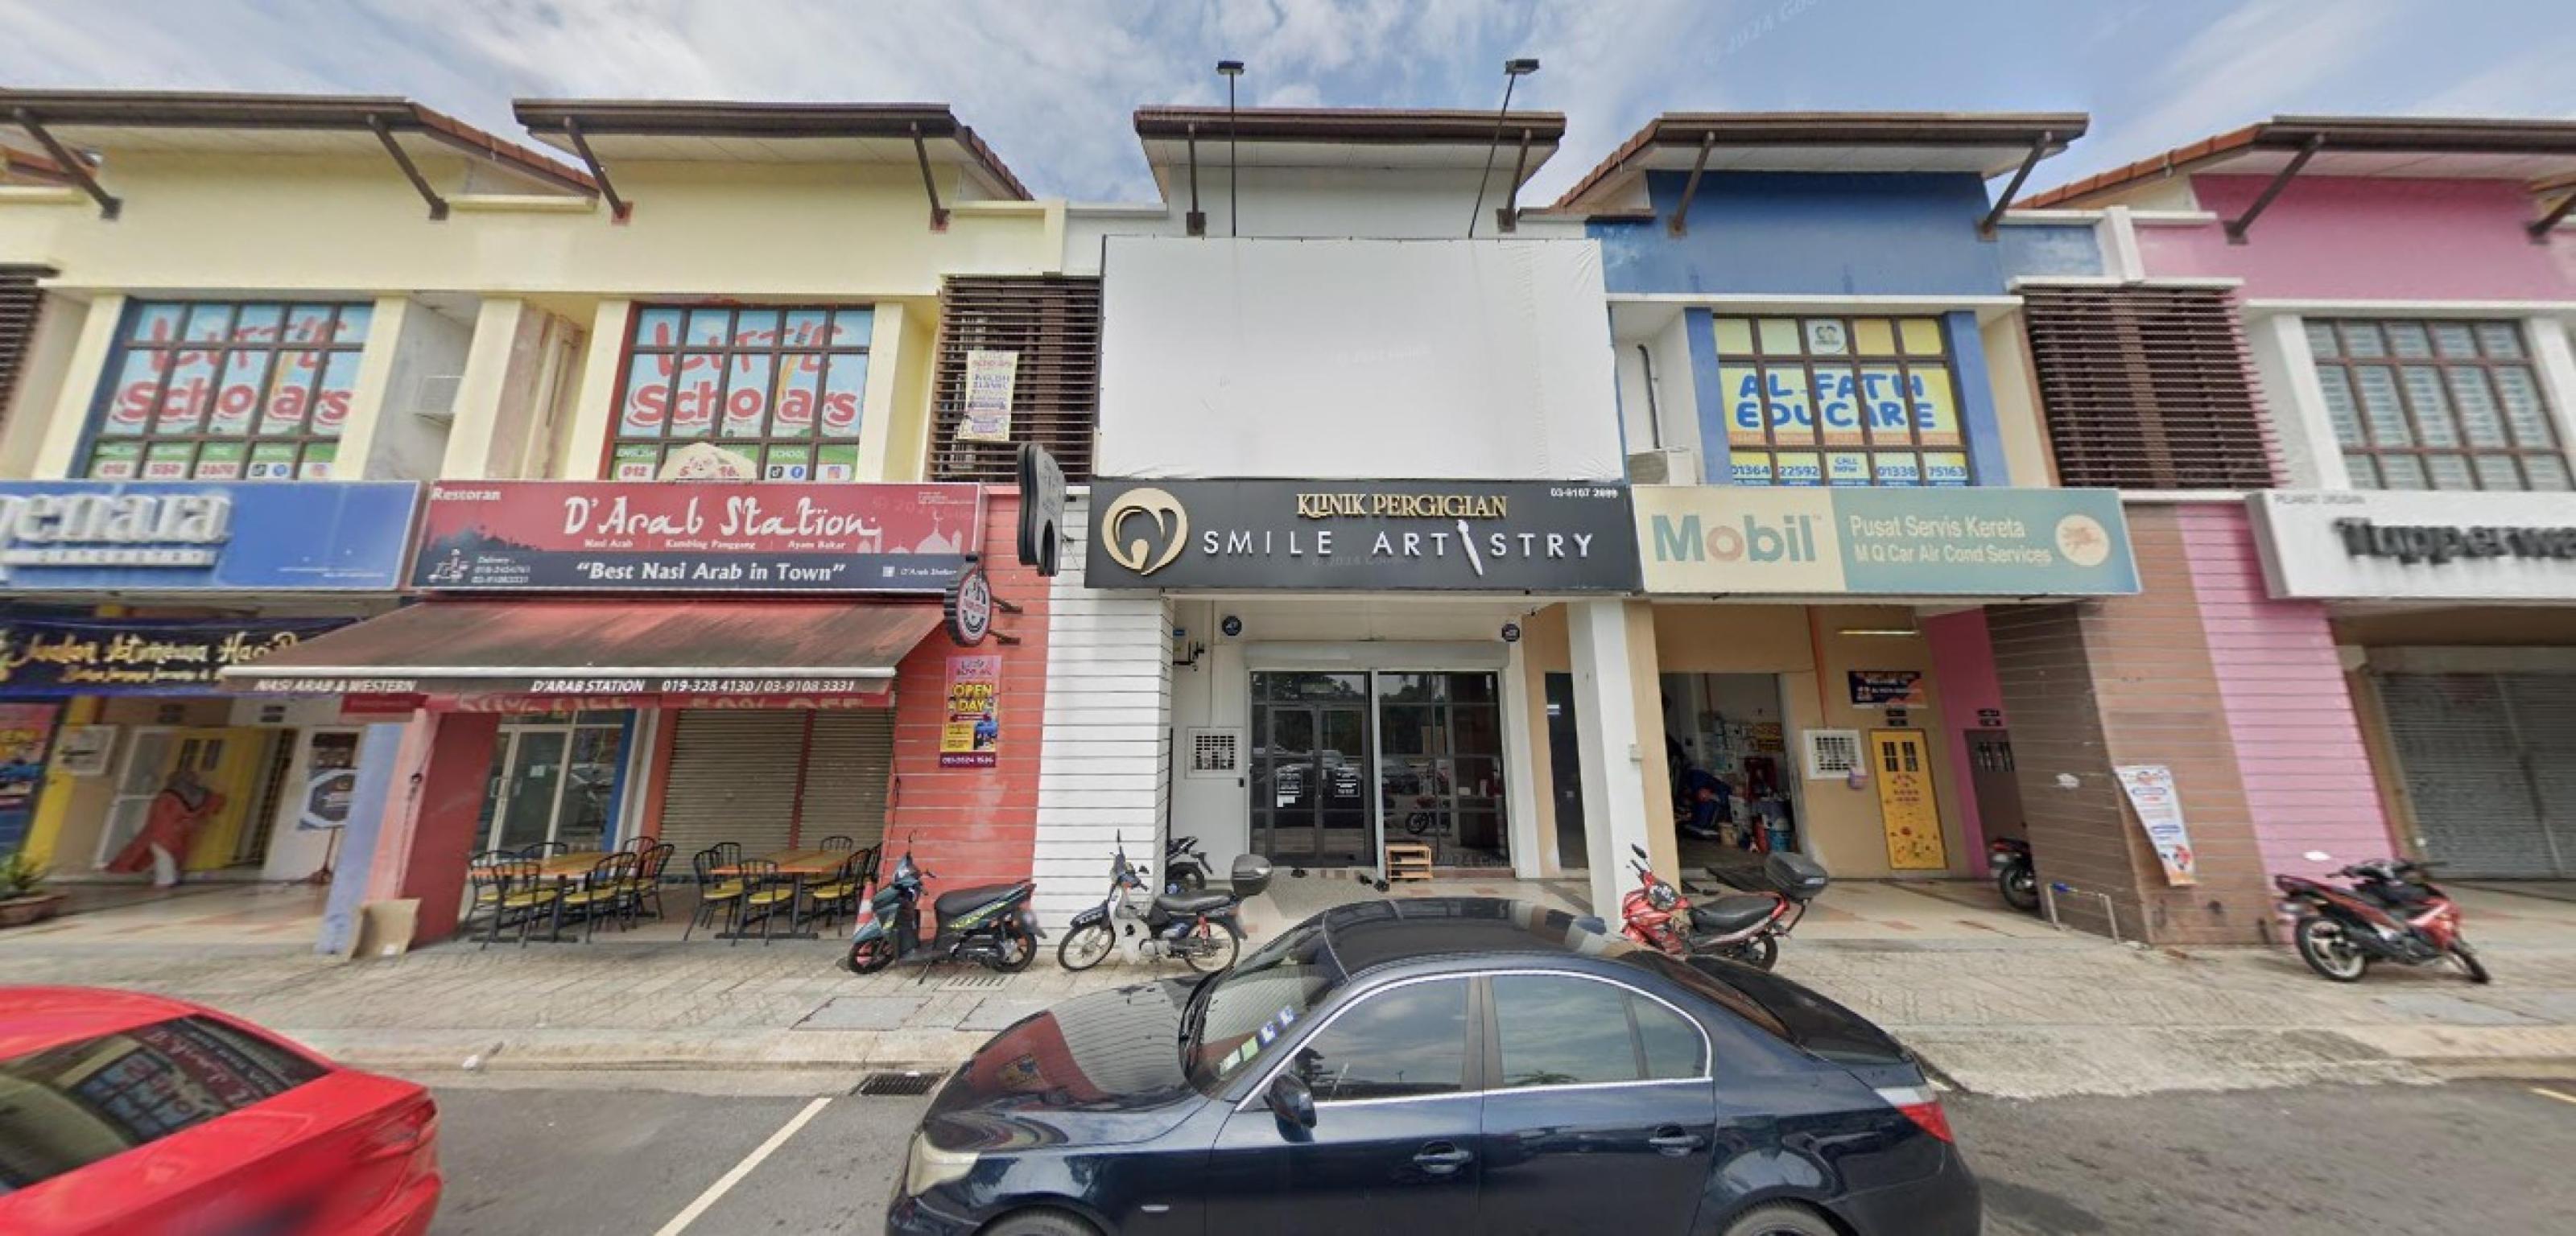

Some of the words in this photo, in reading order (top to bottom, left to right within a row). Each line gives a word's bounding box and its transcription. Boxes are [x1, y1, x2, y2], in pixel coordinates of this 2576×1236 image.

[1834, 456, 1858, 465] CALL
[431, 488, 502, 501] Restoran
[1372, 493, 1508, 517] PERGIGIAN
[0, 492, 232, 543] enara
[564, 495, 704, 535] D'Arab
[720, 495, 878, 536] Station
[1848, 514, 1902, 537] Pusat
[1905, 515, 1963, 538] Servis
[1964, 515, 2027, 538] Kereta
[584, 538, 608, 549] Nasi
[610, 538, 634, 549] Arab
[1203, 530, 1333, 557] SMILE
[1650, 513, 1816, 562] Mobil
[1854, 543, 1868, 562] M
[1871, 544, 1885, 563] Q
[1887, 544, 1915, 562] Car
[1919, 544, 1940, 562] Air
[1942, 545, 1984, 563] Cond
[1985, 545, 2054, 566] Services
[642, 561, 686, 580] Nasi
[691, 561, 742, 580] Arab
[749, 561, 768, 580] in
[292, 678, 335, 692] ARAB
[348, 678, 417, 692] WESTERN
[530, 679, 584, 692] D'ARAB
[584, 679, 646, 692] STATION
[662, 679, 716, 692] 019-328
[719, 679, 753, 693] 4130
[763, 680, 820, 693] 03-9108
[819, 680, 855, 693] 3331
[952, 684, 993, 698] OPEN
[956, 698, 985, 712] DAY
